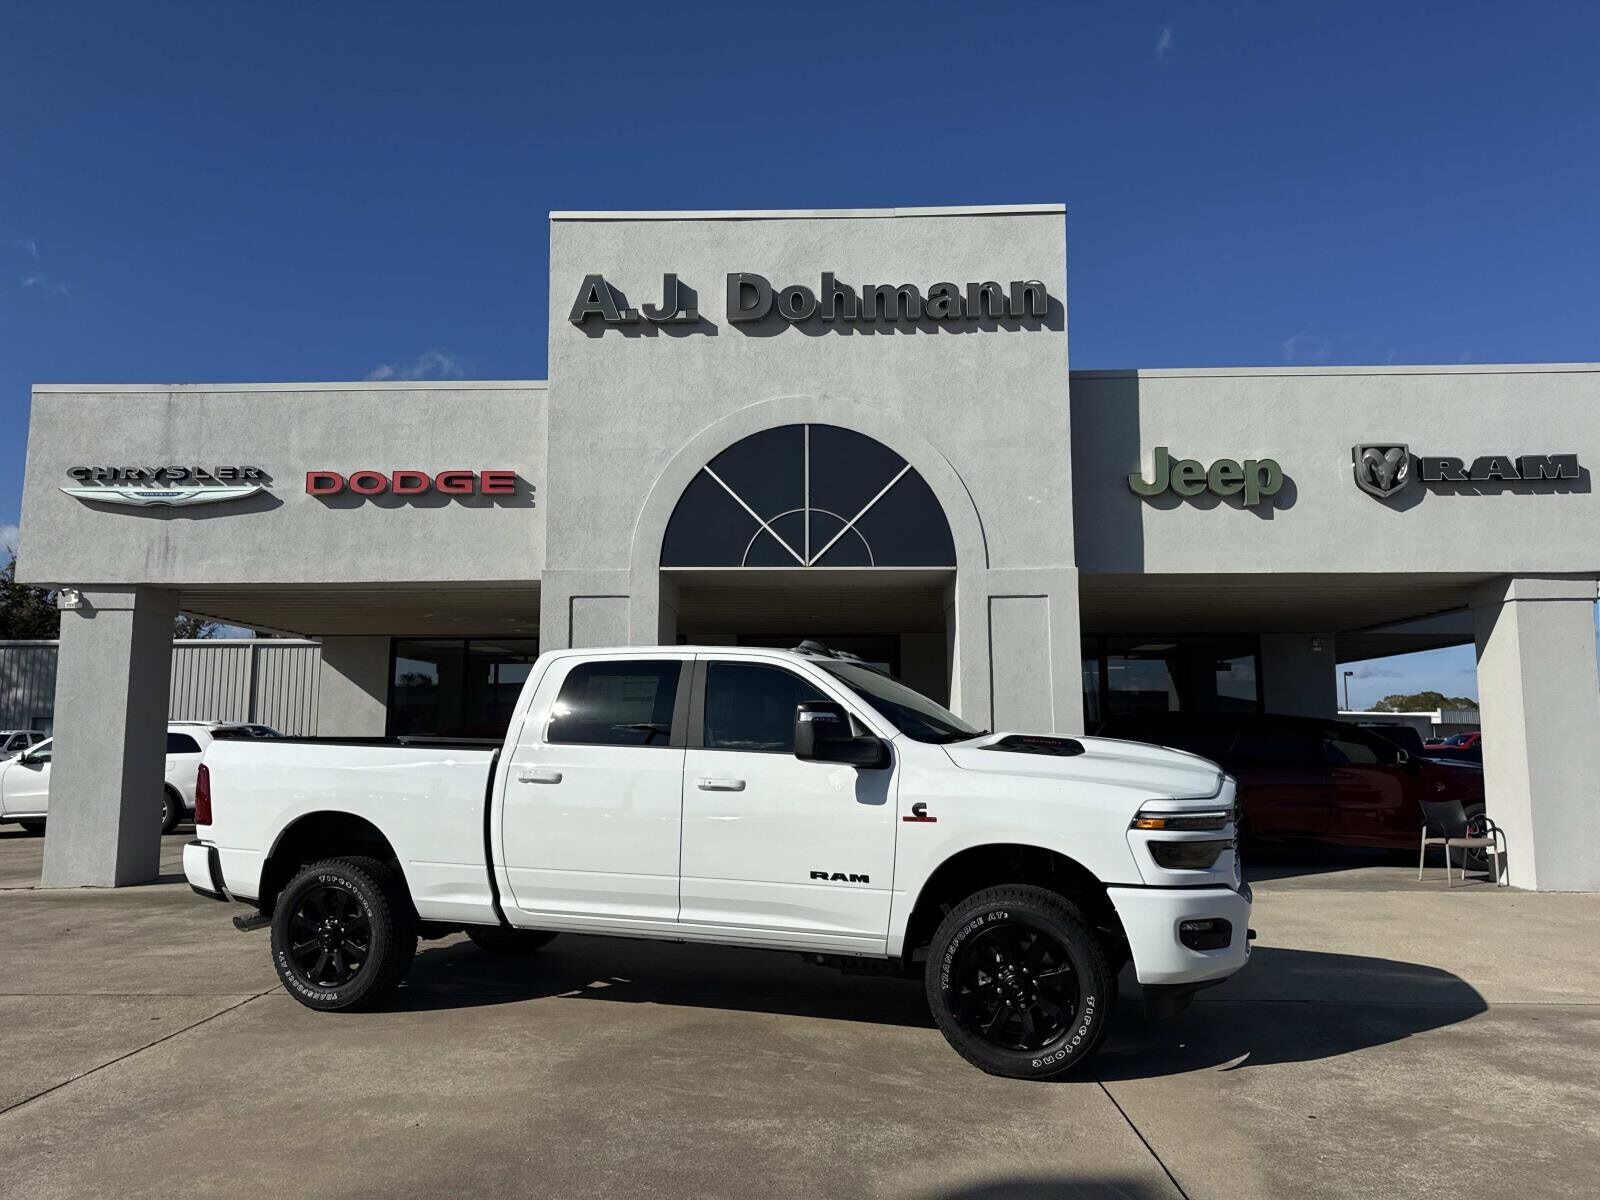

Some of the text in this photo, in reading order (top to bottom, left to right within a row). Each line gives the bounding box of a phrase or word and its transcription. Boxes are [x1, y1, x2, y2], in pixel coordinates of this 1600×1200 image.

[568, 270, 1048, 324] A.J. Dohmann
[66, 466, 262, 480] CHRYSLER
[1128, 446, 1284, 506] Jeep
[1419, 454, 1580, 481] RAM
[306, 470, 516, 495] DODGE
[810, 871, 870, 883] RAM
